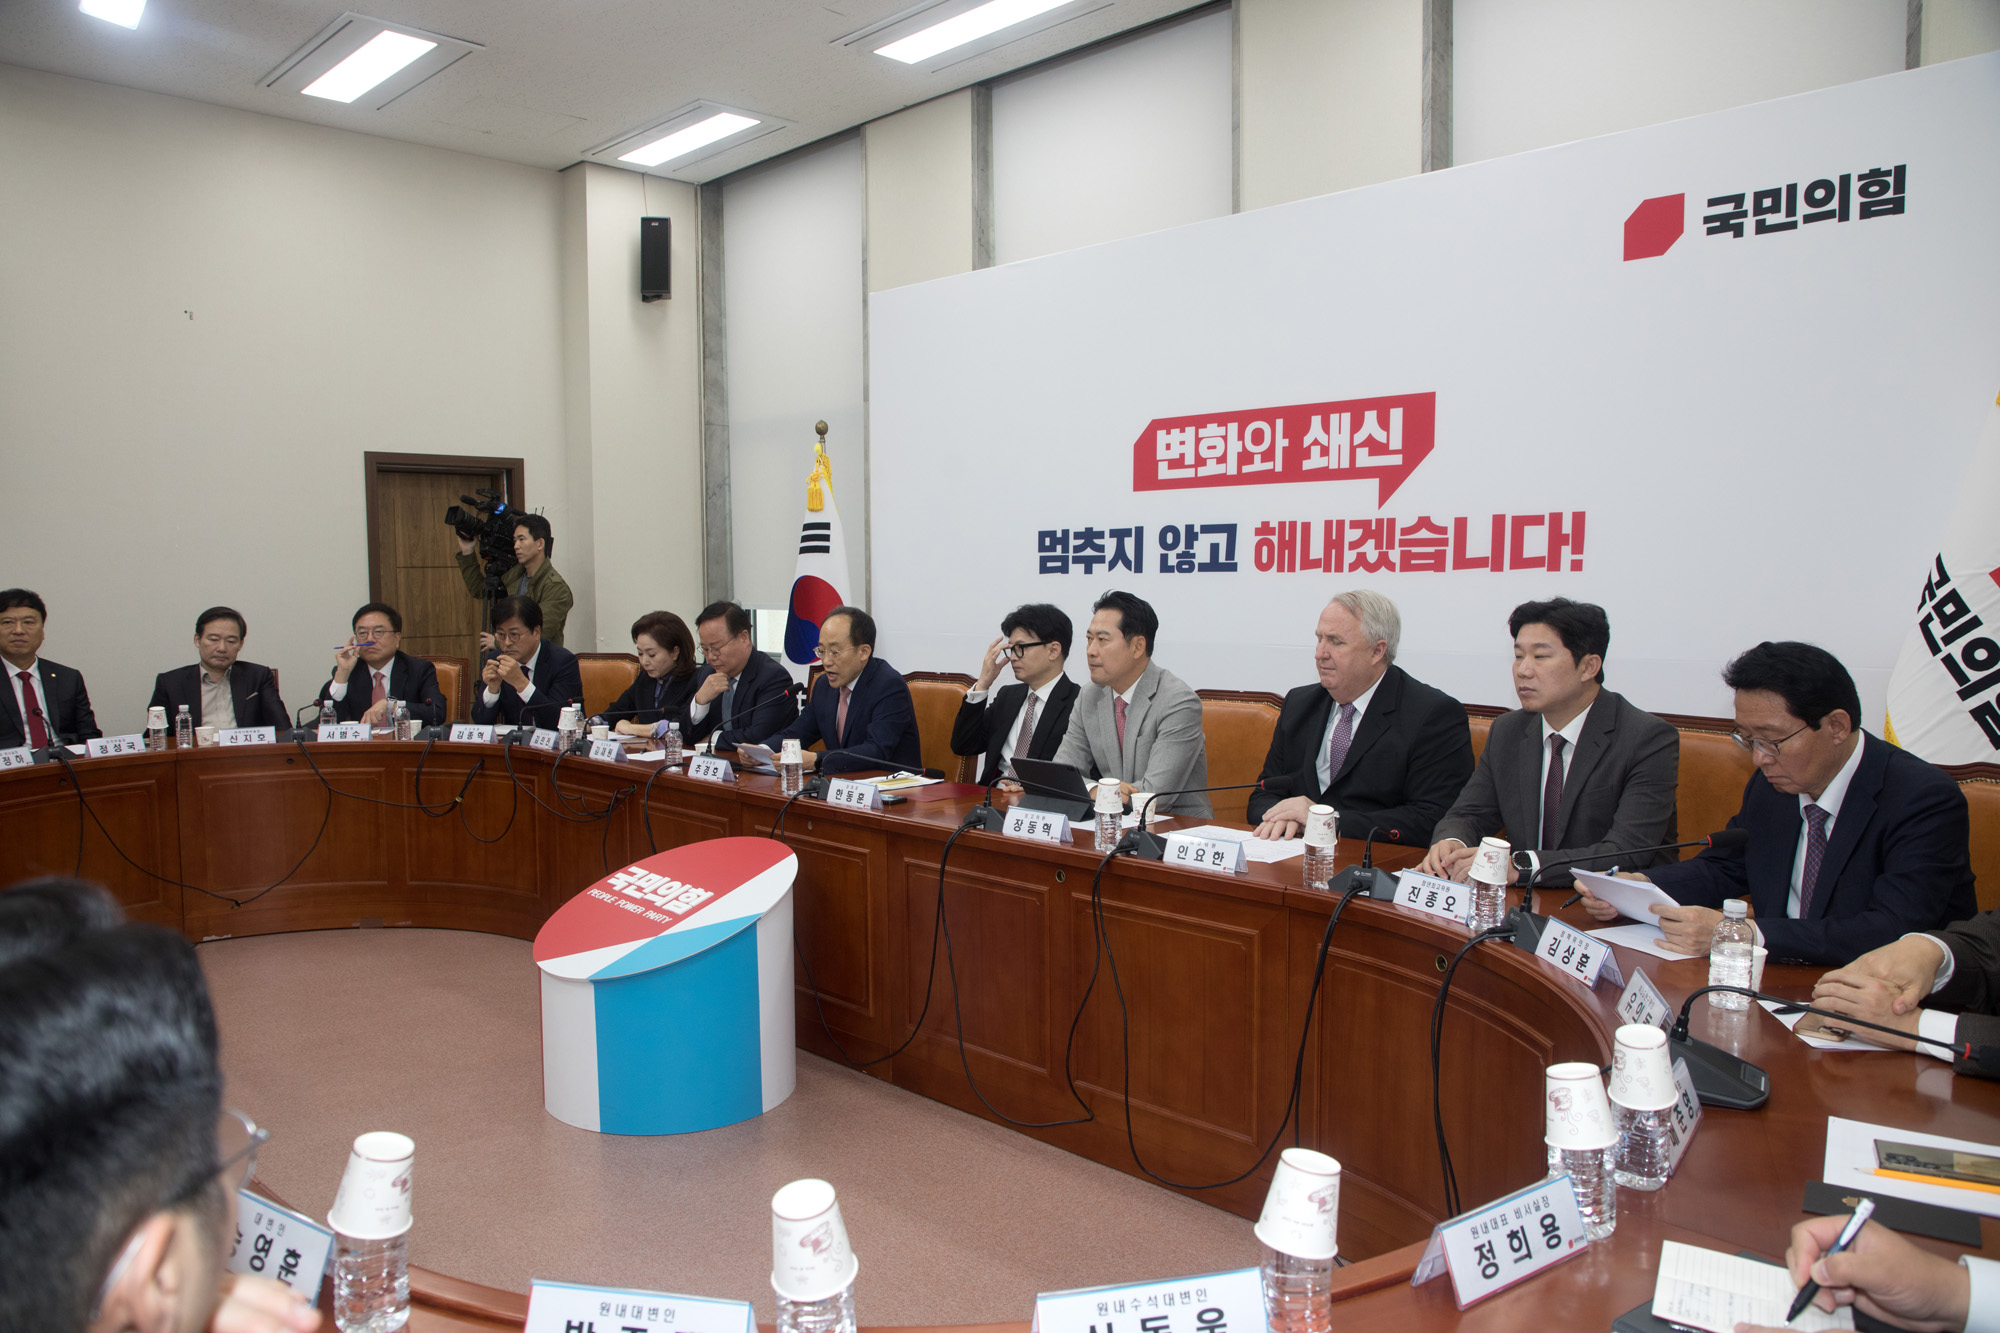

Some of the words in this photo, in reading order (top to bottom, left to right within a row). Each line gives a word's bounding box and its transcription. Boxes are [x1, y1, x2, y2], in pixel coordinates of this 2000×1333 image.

[1703, 164, 1907, 239] 국민의힘
[1155, 419, 1289, 480] 변화와
[1302, 407, 1404, 471] 쇄신
[1037, 526, 1145, 575] 멈추지
[1158, 523, 1239, 574] 않고
[1254, 511, 1587, 573] 해내겠습니다!
[99, 741, 136, 755] 정성국
[229, 733, 267, 744] 신지호
[326, 729, 361, 740] 서범수
[835, 789, 865, 805] 한동훈
[1013, 818, 1053, 837] 장동혁
[1177, 845, 1225, 867] 인요한
[587, 888, 618, 904] PEOPLE
[614, 899, 646, 915] POWER
[642, 910, 673, 924] PARTY
[607, 866, 715, 916] 국민의힘
[1408, 886, 1457, 913] 진종오
[1548, 937, 1591, 974] 김상훈
[1470, 1213, 1509, 1240] 원내대표
[1514, 1195, 1550, 1220] 비서실장
[1474, 1213, 1562, 1280] 정희용
[599, 1301, 676, 1324] 원내대변인
[1096, 1287, 1208, 1317] 원내수석대변인
